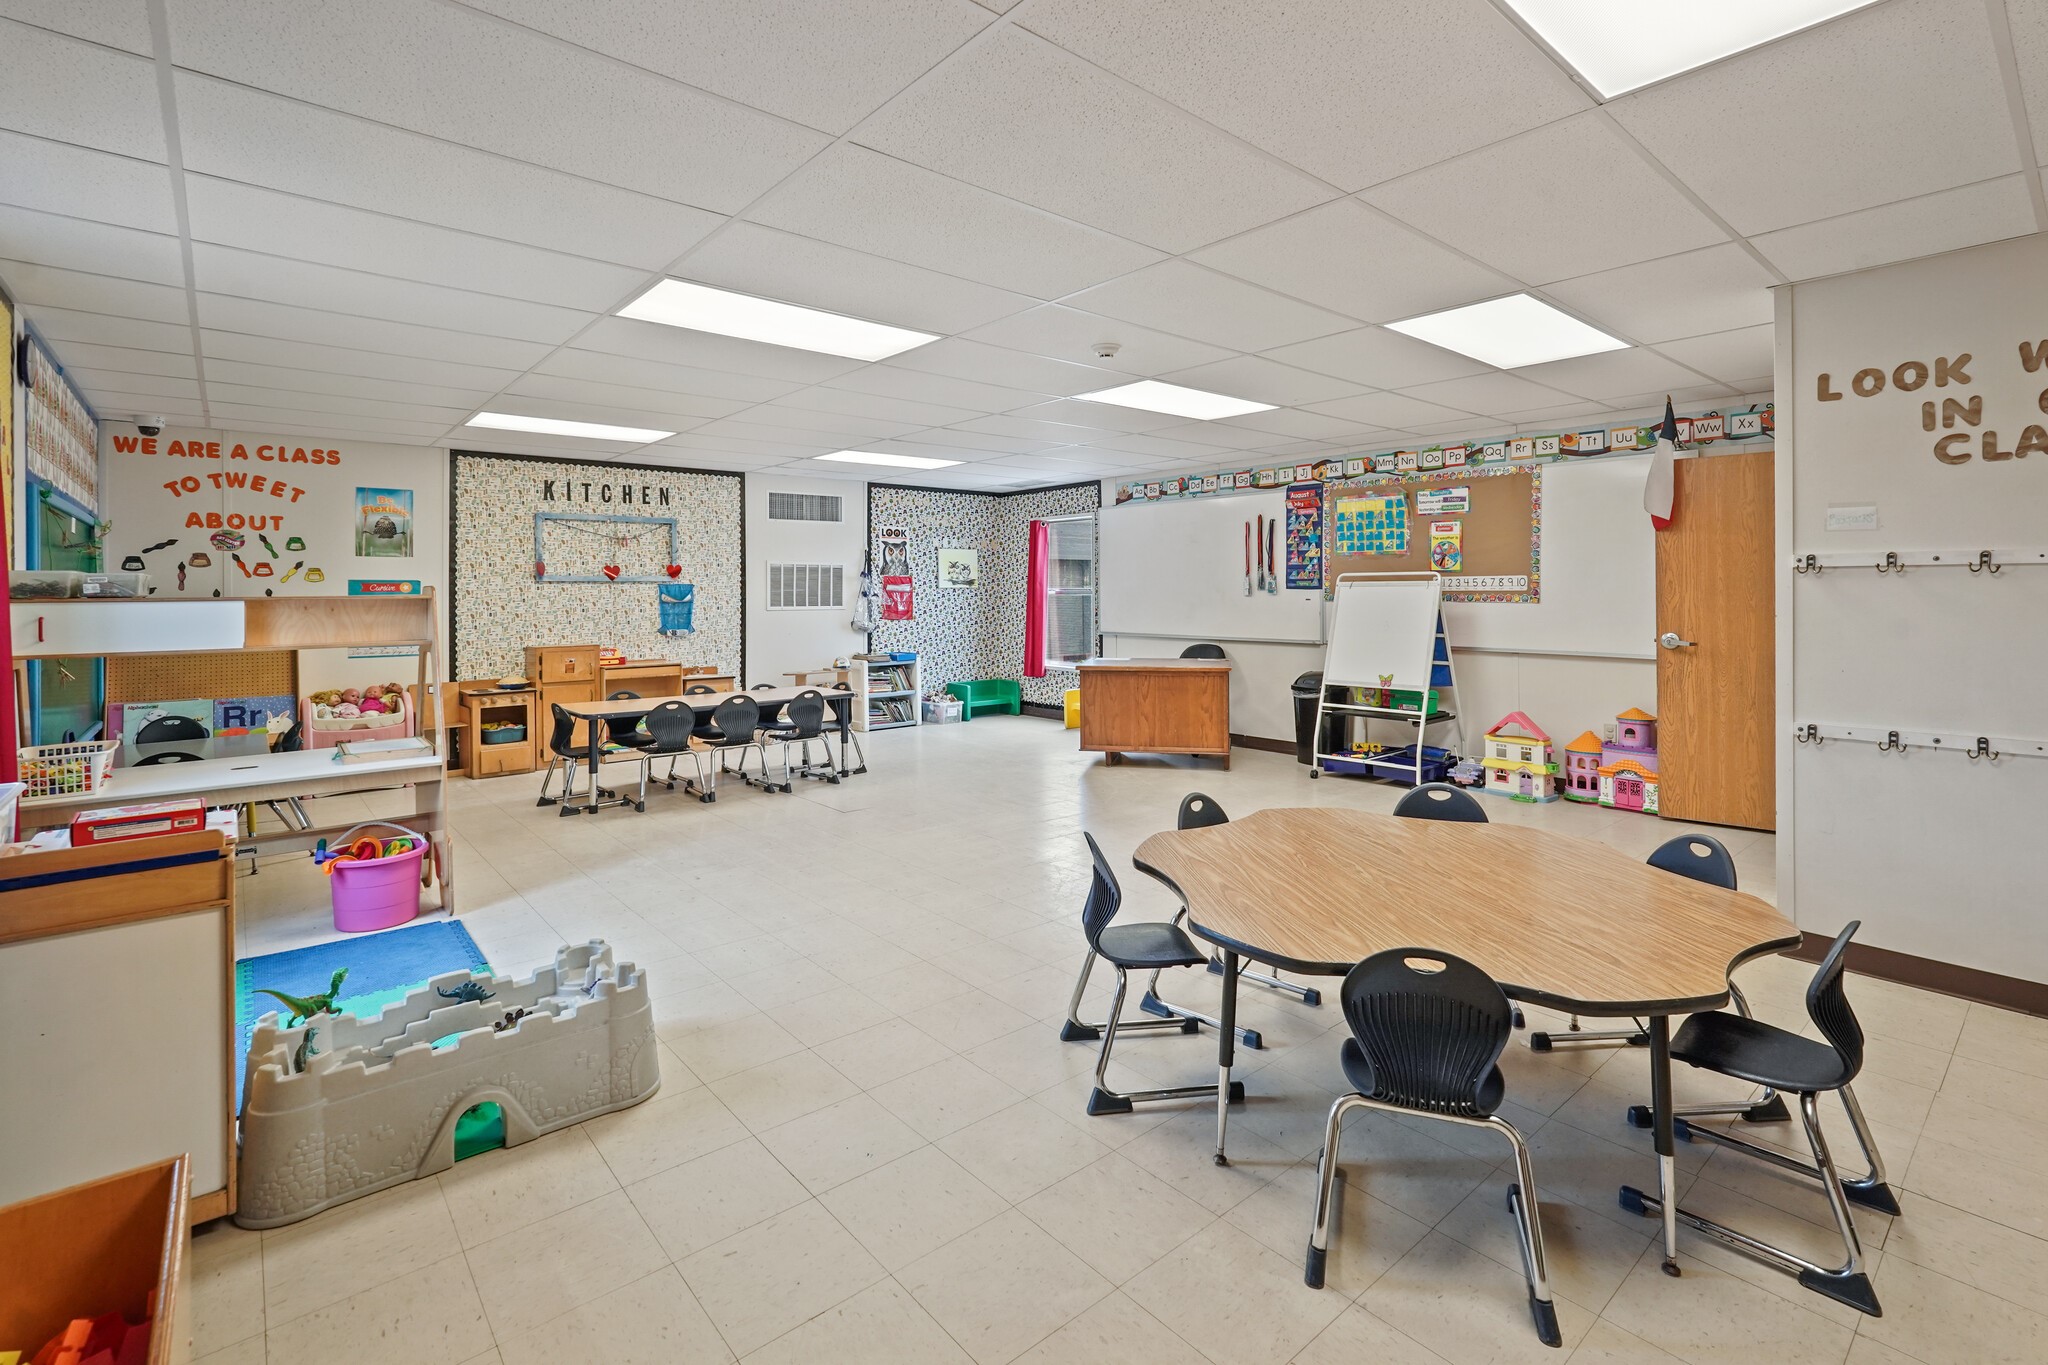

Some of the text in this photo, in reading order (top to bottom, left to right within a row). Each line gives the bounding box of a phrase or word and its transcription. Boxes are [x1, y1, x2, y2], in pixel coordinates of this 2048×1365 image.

[1817, 353, 1972, 402] LOOK
[1921, 395, 1983, 432] IN
[113, 435, 341, 465] WE ARE A CLASS
[1168, 483, 1178, 491] Cc
[1237, 476, 1249, 486] Gg
[1261, 473, 1272, 481] Hh
[1300, 469, 1308, 479] Jj
[1329, 464, 1339, 473] Kk
[1352, 462, 1360, 470] Ll
[1377, 457, 1394, 467] Mm
[1401, 456, 1414, 465] Nn
[1425, 453, 1440, 463] Oo
[1449, 451, 1462, 464] Pp
[1485, 446, 1503, 458] Qq
[1515, 443, 1526, 453] Rr
[1541, 440, 1554, 450] Ss
[1586, 436, 1598, 446] Tt
[1615, 432, 1632, 443] Uu
[1696, 422, 1720, 434] Ww
[1738, 418, 1754, 429] Xx
[1933, 424, 2048, 465] CLA
[163, 472, 306, 503] TO TWEET
[543, 480, 670, 505] KITCHEN
[361, 505, 409, 518] Flexible
[377, 496, 393, 505] Be
[185, 512, 284, 531] ABOUT
[881, 528, 907, 537] LOOK
[369, 584, 396, 592] Cursive
[223, 704, 262, 728] Rr
